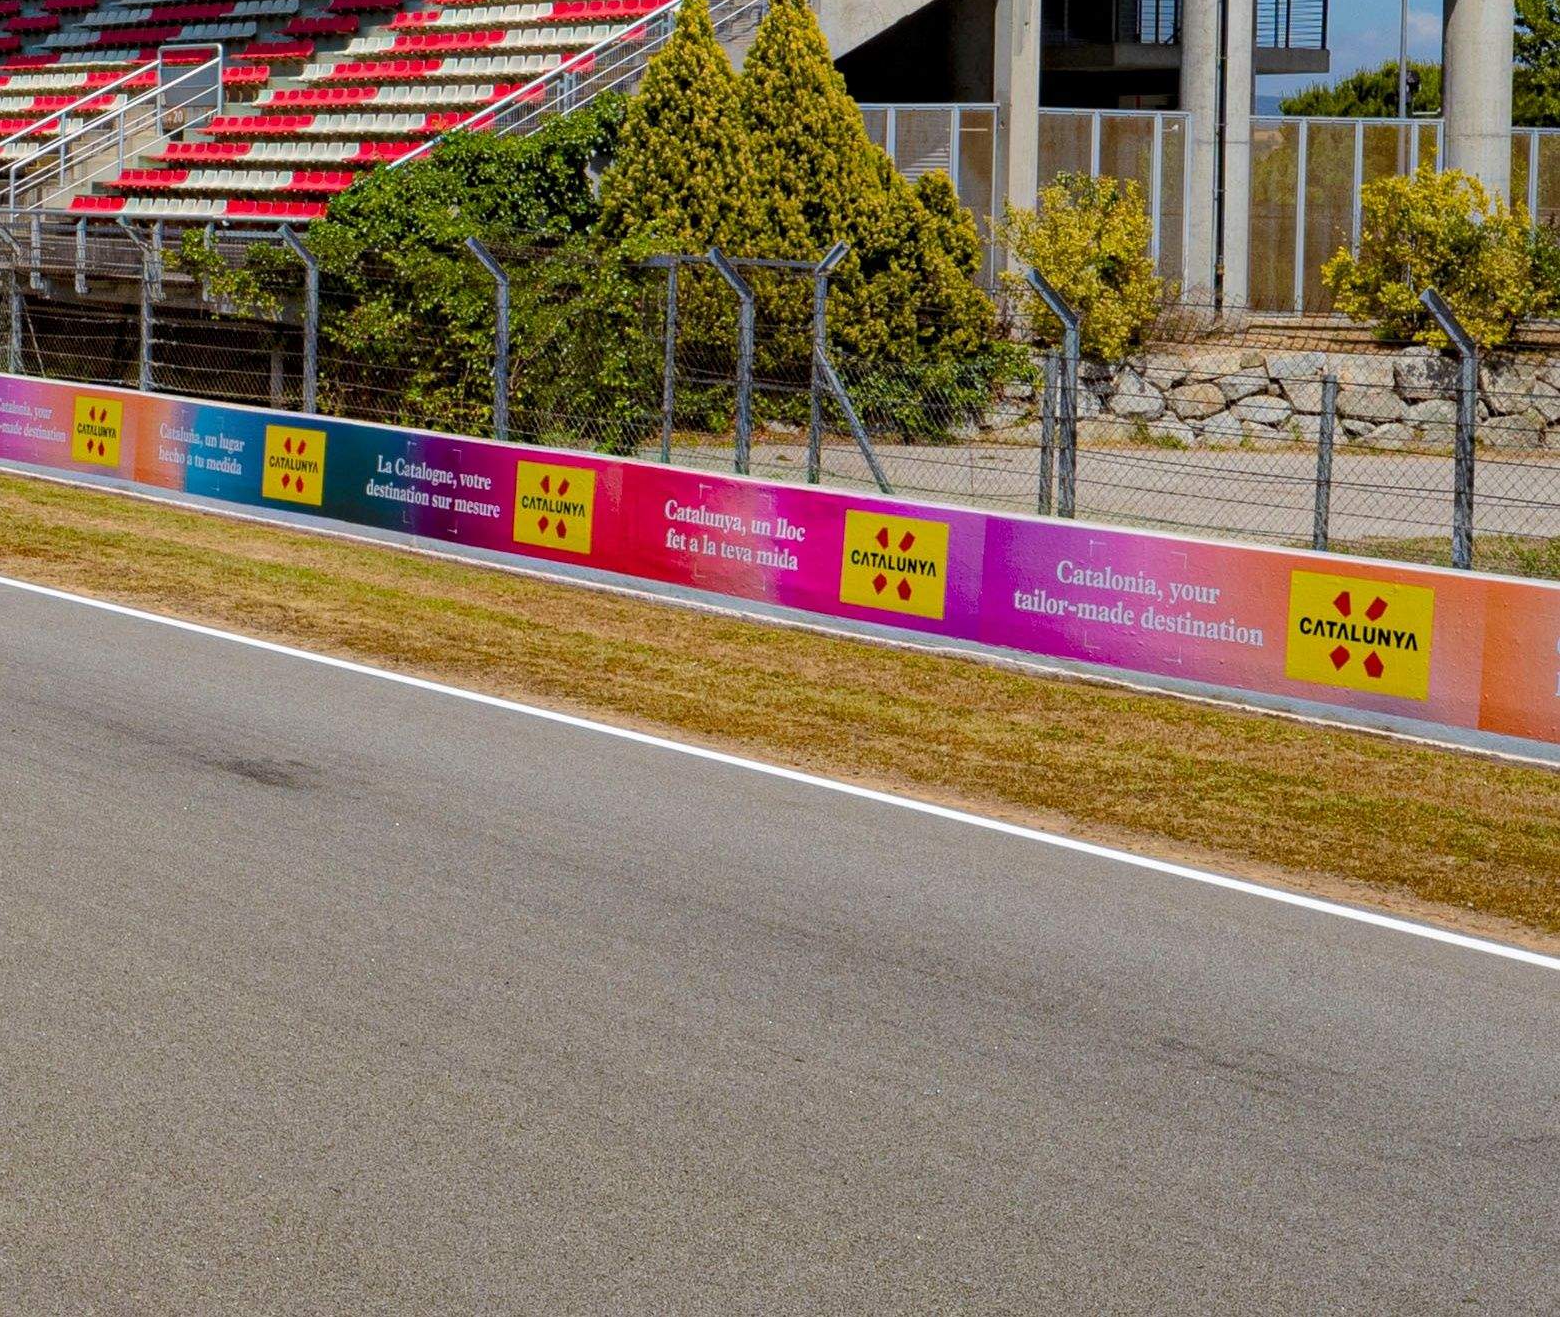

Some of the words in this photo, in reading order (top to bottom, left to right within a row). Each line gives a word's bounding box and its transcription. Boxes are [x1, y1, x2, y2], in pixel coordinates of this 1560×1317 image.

[34, 406, 52, 421] your
[24, 423, 66, 442] destination
[77, 422, 117, 439] CATALUNYA
[205, 435, 218, 446] un
[220, 432, 245, 454] lugar
[159, 445, 185, 464] hecho
[186, 454, 193, 465] a
[194, 455, 204, 468] tu
[206, 455, 242, 475] medida
[268, 455, 319, 475] CATALUNYA
[378, 454, 392, 473] La
[394, 459, 458, 489] Catalogne,
[460, 470, 491, 490] votre
[366, 481, 429, 507] destination
[432, 494, 452, 511] sur
[454, 496, 500, 519] mesure
[522, 494, 585, 518] CATALUNYA
[664, 499, 747, 538] Catalunya,
[751, 521, 772, 537] un
[776, 519, 806, 542] lloc
[666, 531, 687, 551] fet
[689, 537, 699, 553] a
[702, 532, 717, 556] la
[721, 541, 752, 563] teva
[756, 544, 798, 571] mida
[851, 549, 937, 577] CATALUNYA
[1057, 560, 1164, 603] Catalonia,
[1169, 580, 1220, 605] your
[1013, 587, 1135, 626] tailor-made
[1140, 604, 1264, 647] destination
[1299, 615, 1419, 652] CATALUNYA
